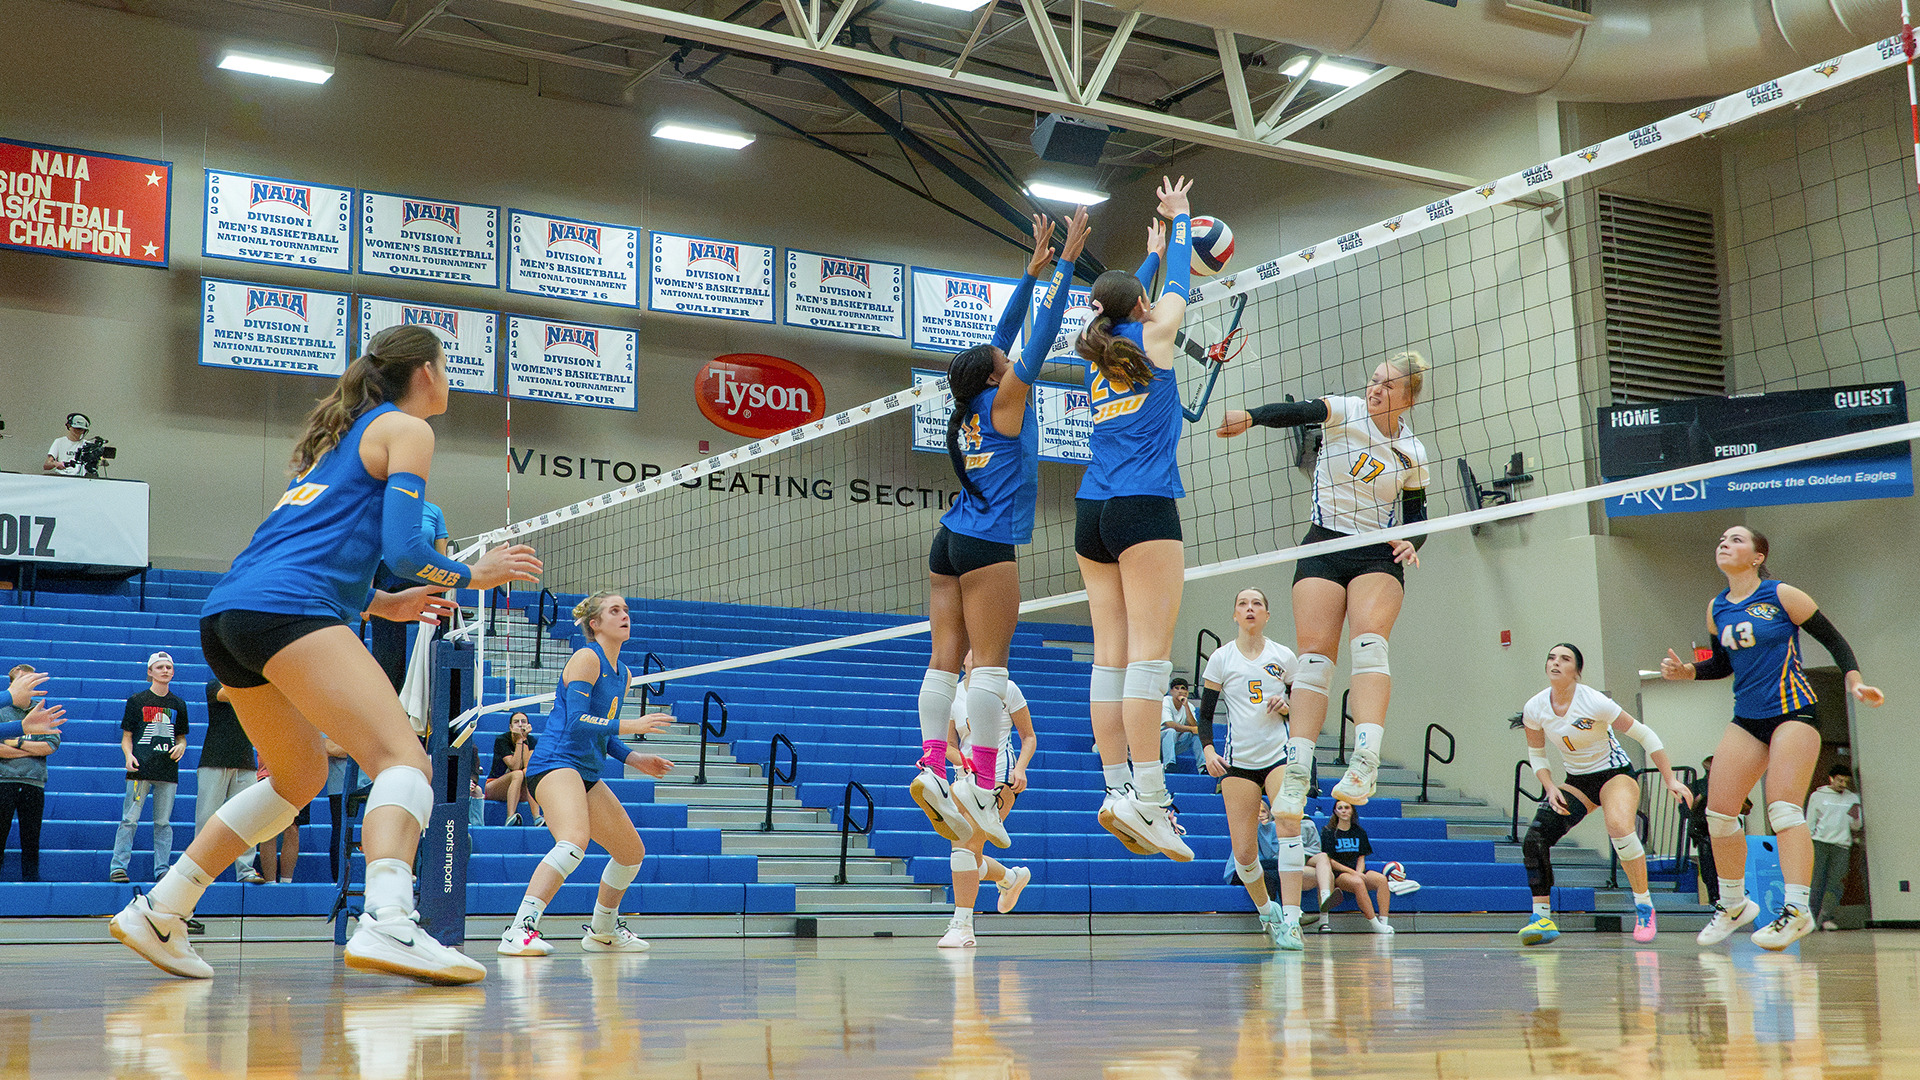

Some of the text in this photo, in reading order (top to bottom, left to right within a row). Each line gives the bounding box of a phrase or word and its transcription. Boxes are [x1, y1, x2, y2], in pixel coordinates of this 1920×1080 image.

[1746, 79, 1778, 98] GOLDEN
[1751, 88, 1783, 107] EAGLES
[1629, 123, 1658, 141] GOLDEN
[1633, 132, 1662, 149] EAGLES
[31, 150, 90, 181] NAIA
[1522, 163, 1549, 178] GOLDEN
[1527, 170, 1553, 186] EAGLES
[74, 180, 81, 203] I
[210, 175, 219, 215] 2003
[252, 183, 308, 212] NAIA
[339, 193, 348, 232] 2003
[365, 195, 373, 234] 2004
[1426, 198, 1450, 213] GOLDEN
[1429, 206, 1454, 221] EAGLES
[247, 211, 312, 228] DIVISION I
[404, 202, 458, 230] NAIA
[9, 219, 131, 256] CHAMPION
[218, 220, 339, 244] MEN'S BASKETBALL
[400, 229, 461, 245] DIVISION I
[486, 210, 494, 248] 2004
[513, 216, 521, 253] 2004
[550, 223, 598, 250] NAIA
[1337, 231, 1360, 245] GOLDEN
[217, 233, 339, 254] NATIONAL TOURNAMENT
[365, 238, 494, 261] WOMEN'S BASKETBALL
[1340, 238, 1363, 252] EAGLES
[239, 248, 317, 264] SWEET 16
[372, 250, 487, 270] NATIONAL TOURNAMENT
[546, 250, 602, 265] DIVISION I
[690, 243, 737, 268] NAIA
[389, 265, 472, 281] QUALIFIER
[520, 258, 627, 280] MEN'S BASKETBALL
[686, 269, 740, 283] DIVISION I
[789, 253, 797, 289] 2006
[822, 260, 868, 285] NAIA
[1256, 260, 1277, 273] GOLDEN
[1260, 267, 1280, 280] EAGLES
[520, 269, 627, 290] NATIONAL TOURNAMENT
[654, 277, 770, 297] WOMEN'S BASKETBALL
[539, 284, 588, 299] SWEET
[660, 289, 764, 306] NATIONAL TOURNAMENT
[820, 285, 872, 299] DIVISION I
[947, 280, 990, 304] NAIA
[1043, 271, 1064, 309] EAGLES
[207, 283, 216, 323] 2012
[248, 289, 305, 318] NAIA
[676, 302, 750, 317] QUALIFIER
[796, 293, 894, 313] MEN'S BASKETBALL
[953, 300, 983, 311] 2010
[336, 298, 345, 336] 2012
[363, 301, 371, 340] 2013
[404, 308, 456, 335] NAIA
[795, 304, 894, 322] NATIONAL TOURNAMENT
[944, 309, 987, 322] DIVISION
[244, 318, 309, 333] DIVISION I
[810, 318, 880, 332] QUALIFIER
[922, 316, 997, 332] MEN'S BASKETB
[922, 326, 960, 337] NATIONAL
[214, 329, 336, 349] MEN'S BASKETBALL
[485, 315, 493, 353] 2013
[546, 326, 597, 352] NAIA
[930, 336, 966, 347] ELITE
[213, 341, 336, 360] NATIONAL TOURNAMENT
[625, 334, 633, 371] 2014
[231, 356, 319, 371] QUALIFIER
[544, 354, 594, 367] DIVISION
[511, 362, 633, 384] WOMEN'S BASKETBALL
[449, 379, 464, 387] 16
[517, 375, 626, 393] NATIONAL TOURNAMENT
[709, 368, 811, 416] Tyson
[528, 388, 615, 404] FINAL FOUR
[1093, 395, 1147, 423] JBU
[1611, 388, 1894, 428] HOME GUEST
[1045, 428, 1074, 437] MEN'S
[1065, 418, 1092, 428] DIVISI
[1044, 437, 1081, 447] NATIONAL
[1714, 443, 1758, 457] PERIOD
[1349, 452, 1386, 484] 17
[1727, 480, 1783, 492] Supports
[1785, 477, 1805, 487] the
[1808, 474, 1851, 487] Golden
[1855, 470, 1897, 484] Eagles
[416, 564, 460, 587] EAGLES
[1721, 621, 1756, 650] 43
[1248, 680, 1263, 704] 5
[580, 713, 609, 726] EAGLES
[1562, 736, 1576, 751] 1
[1335, 838, 1359, 849] JBU
[443, 820, 455, 893] sports imports
